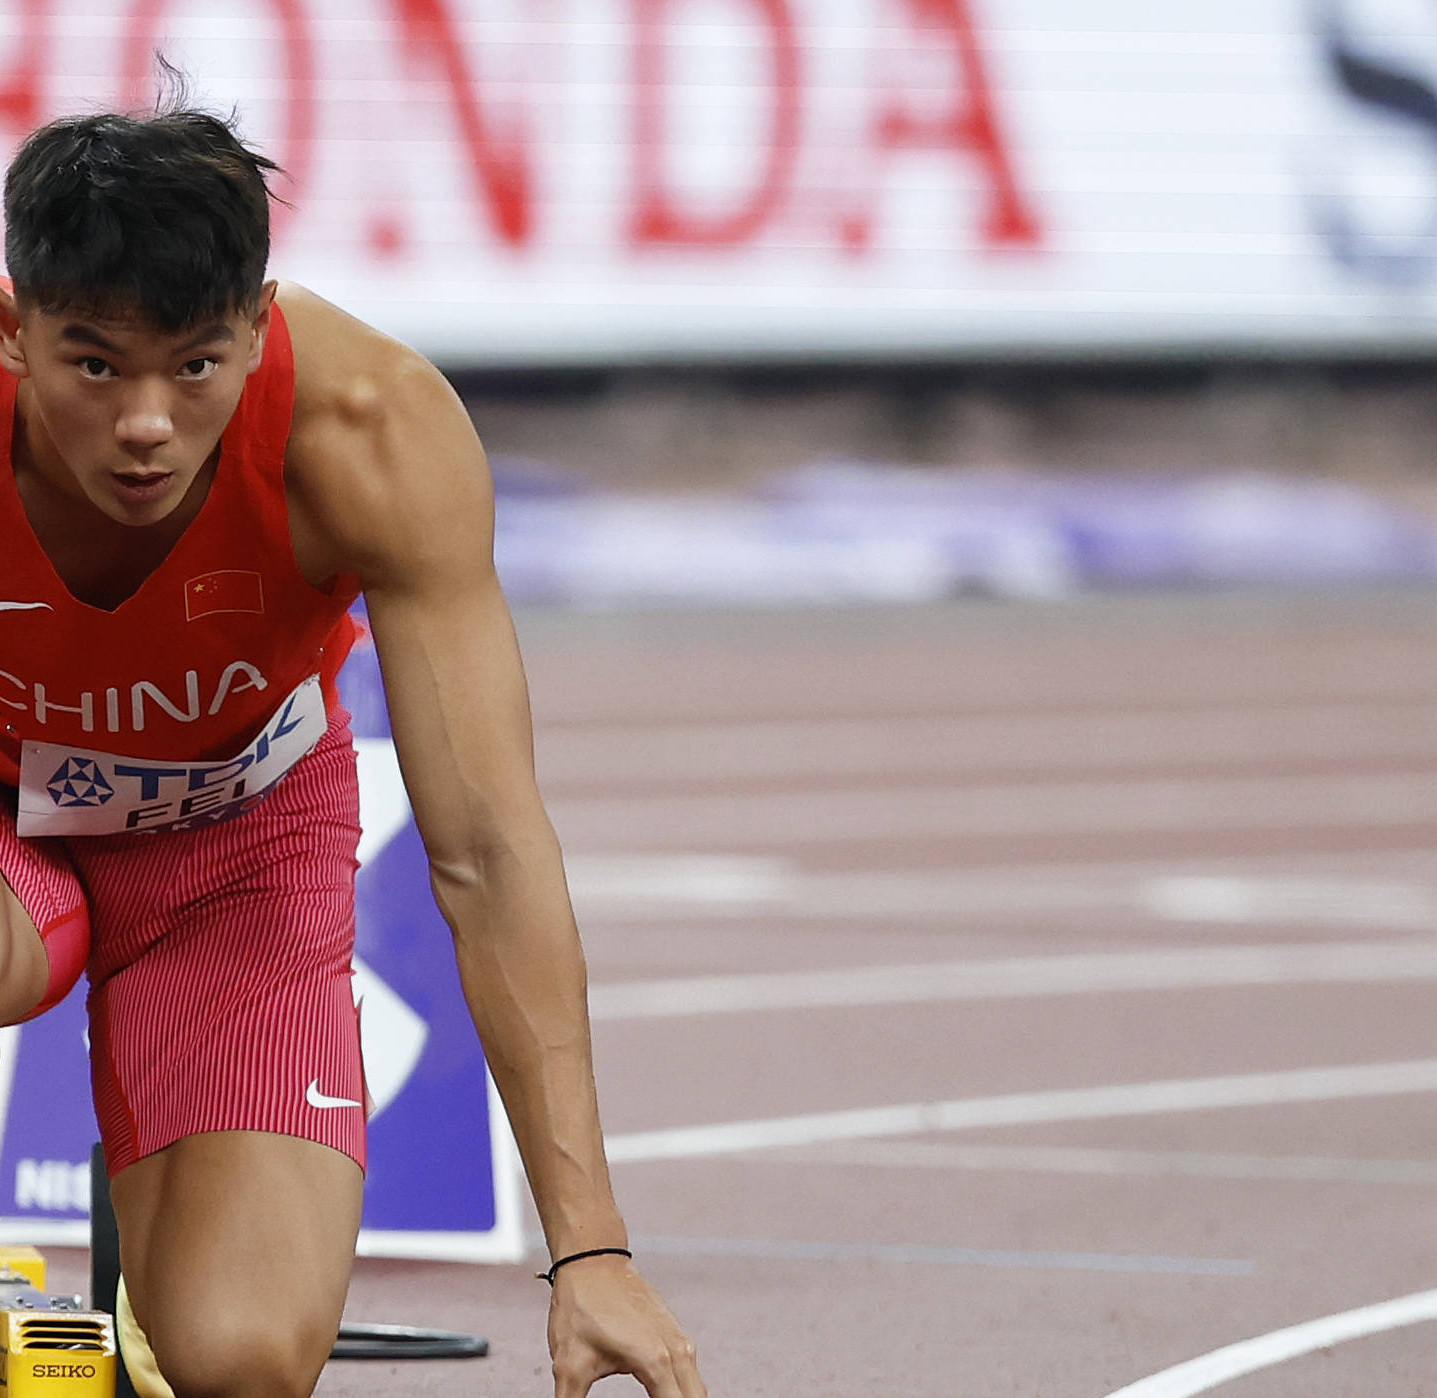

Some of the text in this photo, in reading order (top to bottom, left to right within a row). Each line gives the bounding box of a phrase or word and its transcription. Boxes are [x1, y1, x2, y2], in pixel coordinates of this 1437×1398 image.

[114, 693, 306, 801] TDK
[126, 778, 246, 828] FEI
[32, 1364, 96, 1379] SEIKO
